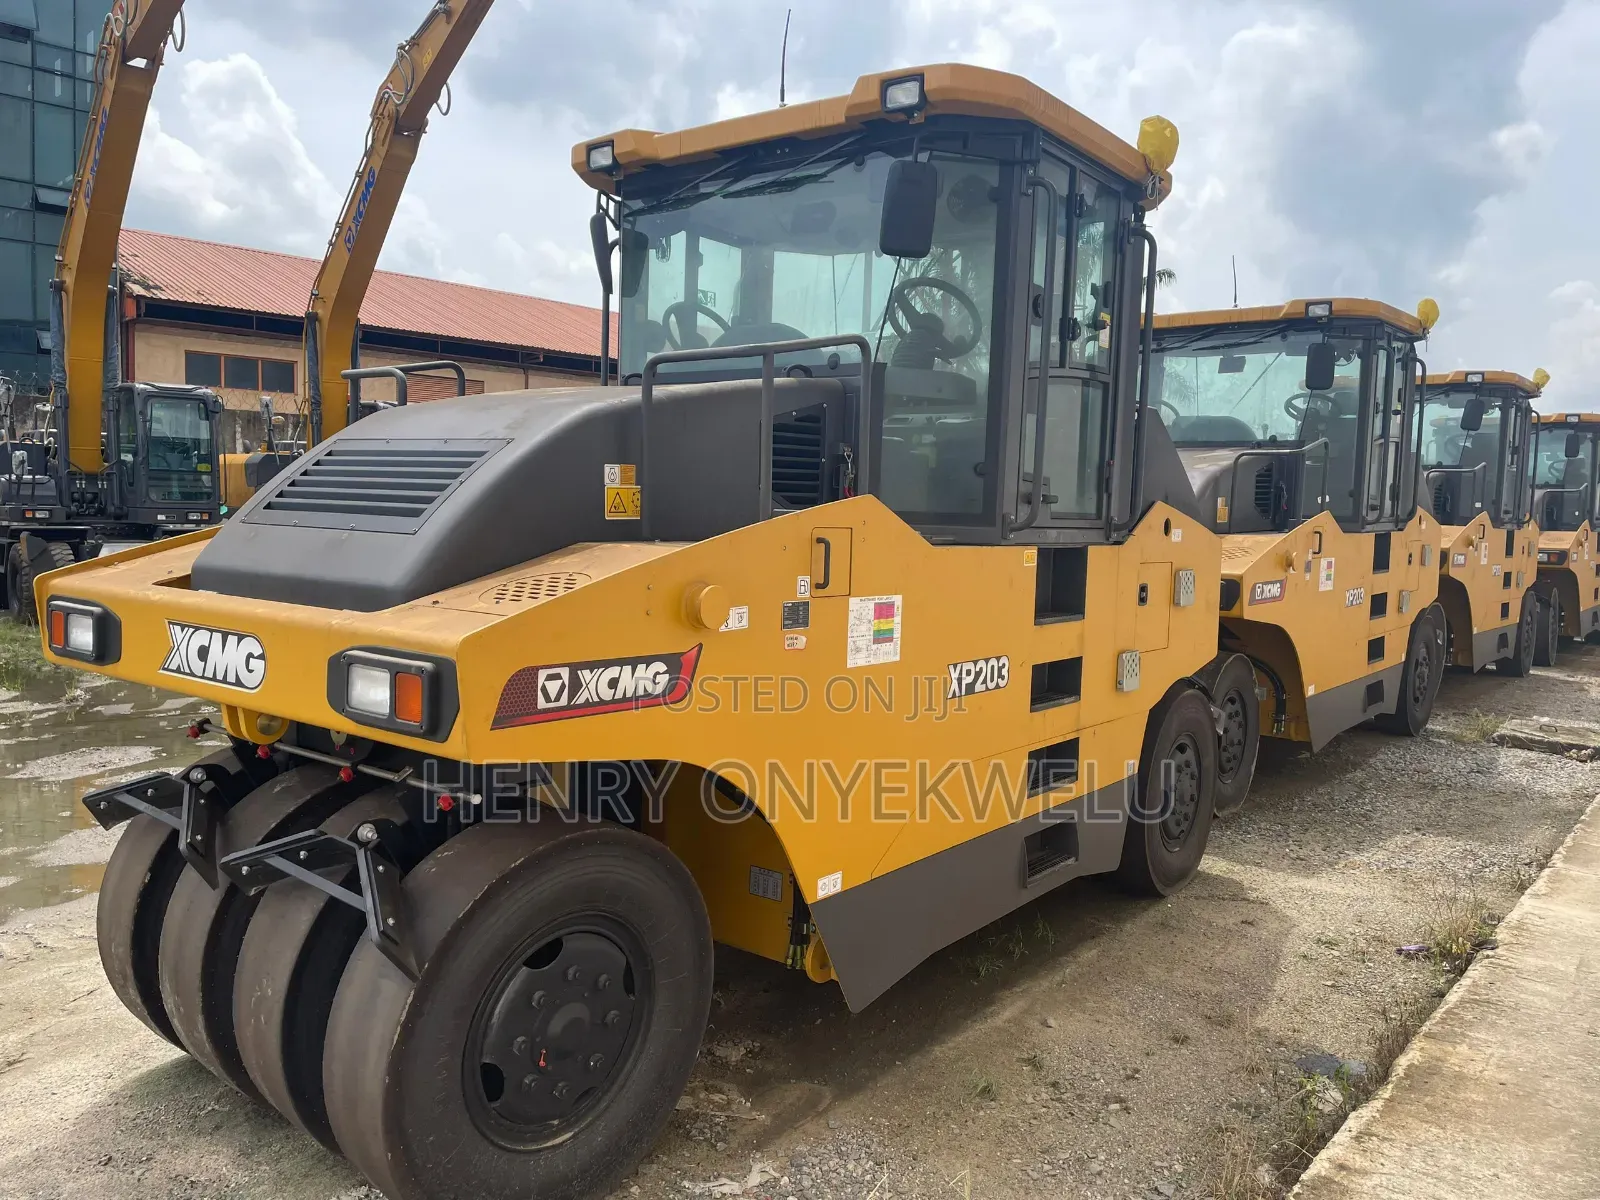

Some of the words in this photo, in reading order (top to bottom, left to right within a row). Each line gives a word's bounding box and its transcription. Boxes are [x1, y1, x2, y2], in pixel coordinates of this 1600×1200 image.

[352, 166, 376, 237] XCMG
[1262, 582, 1281, 599] XCMG
[160, 622, 266, 690] XCMG
[947, 655, 1009, 699] XP203
[570, 661, 670, 705] XCMG
